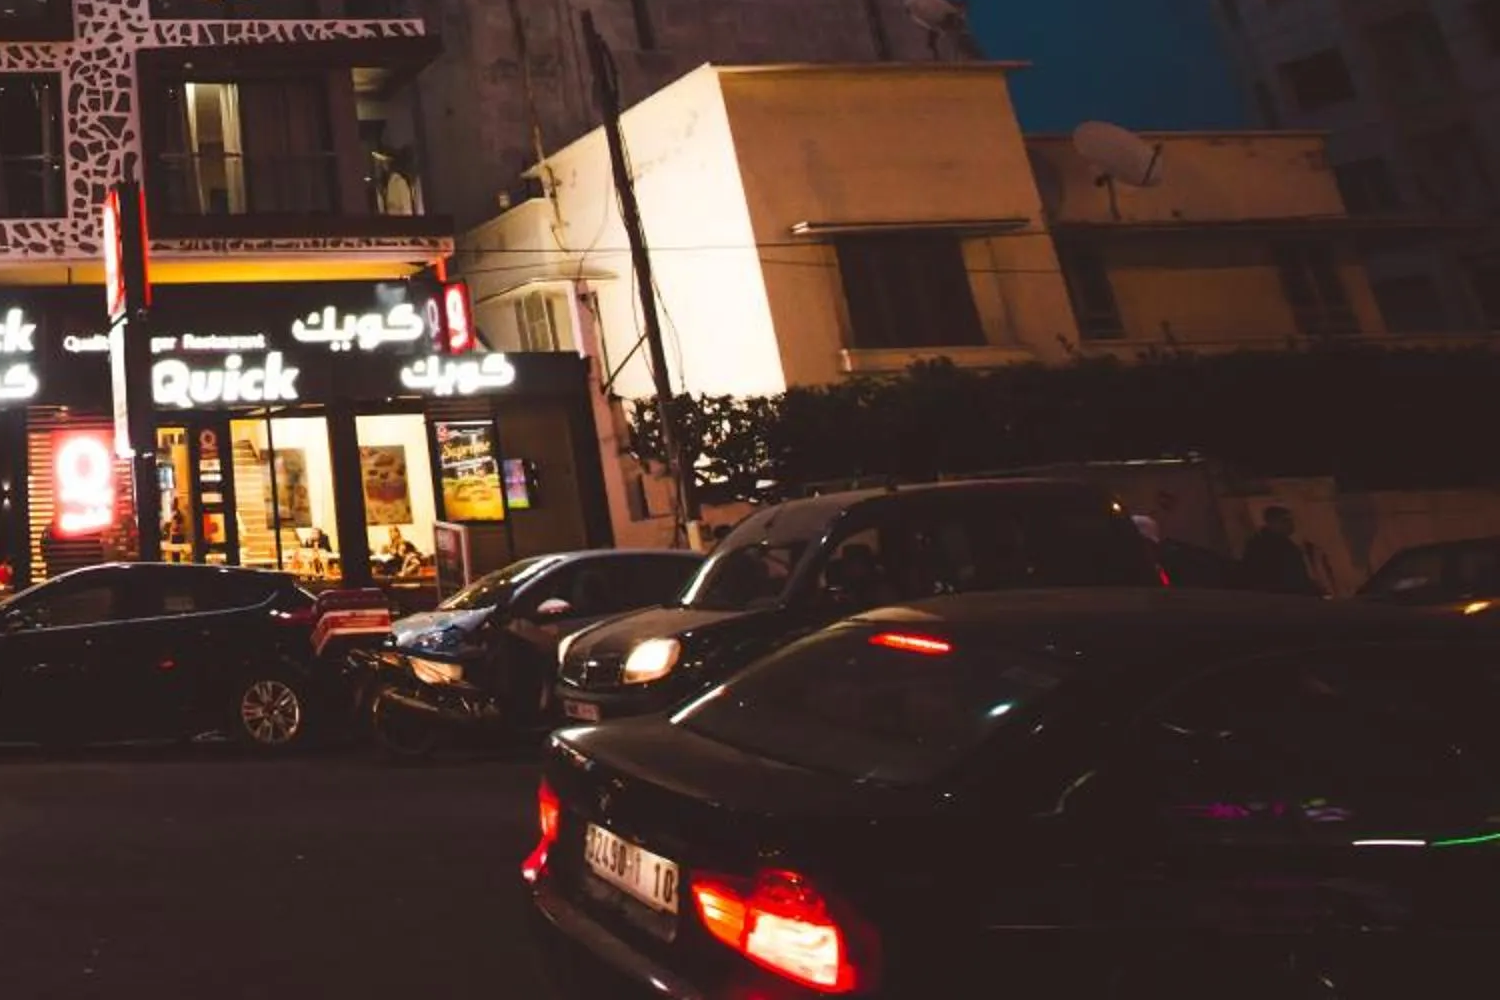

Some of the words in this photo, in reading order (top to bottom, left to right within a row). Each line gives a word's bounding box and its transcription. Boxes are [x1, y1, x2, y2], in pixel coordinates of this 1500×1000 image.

[292, 303, 424, 351] كويك
[152, 351, 300, 408] Quick
[401, 353, 516, 395] كويك
